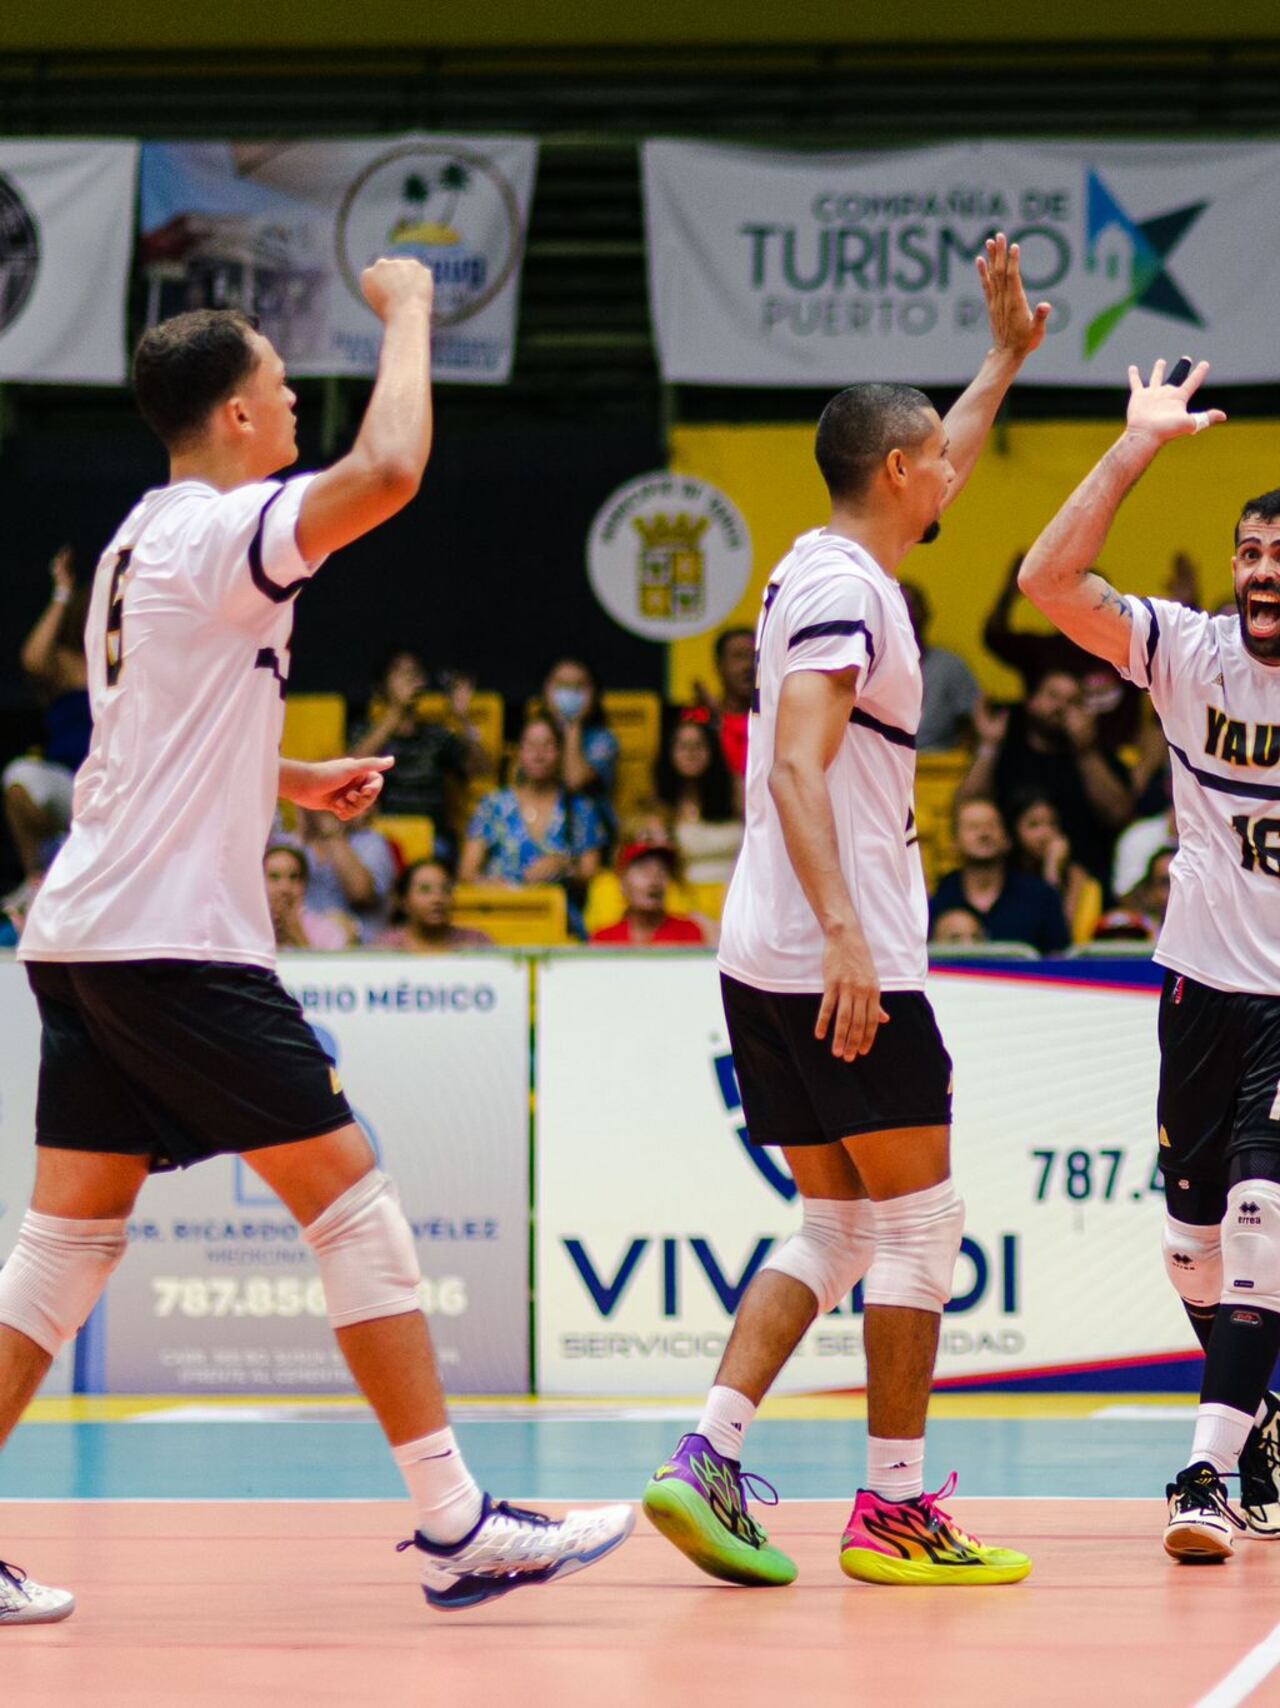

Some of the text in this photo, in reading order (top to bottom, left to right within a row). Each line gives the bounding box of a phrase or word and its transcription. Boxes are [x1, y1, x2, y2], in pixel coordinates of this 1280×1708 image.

[1021, 187, 1068, 219] DE
[741, 222, 1071, 293] TURISMO
[763, 298, 1072, 337] PUERTO RO
[366, 977, 496, 1014] MÉDICO
